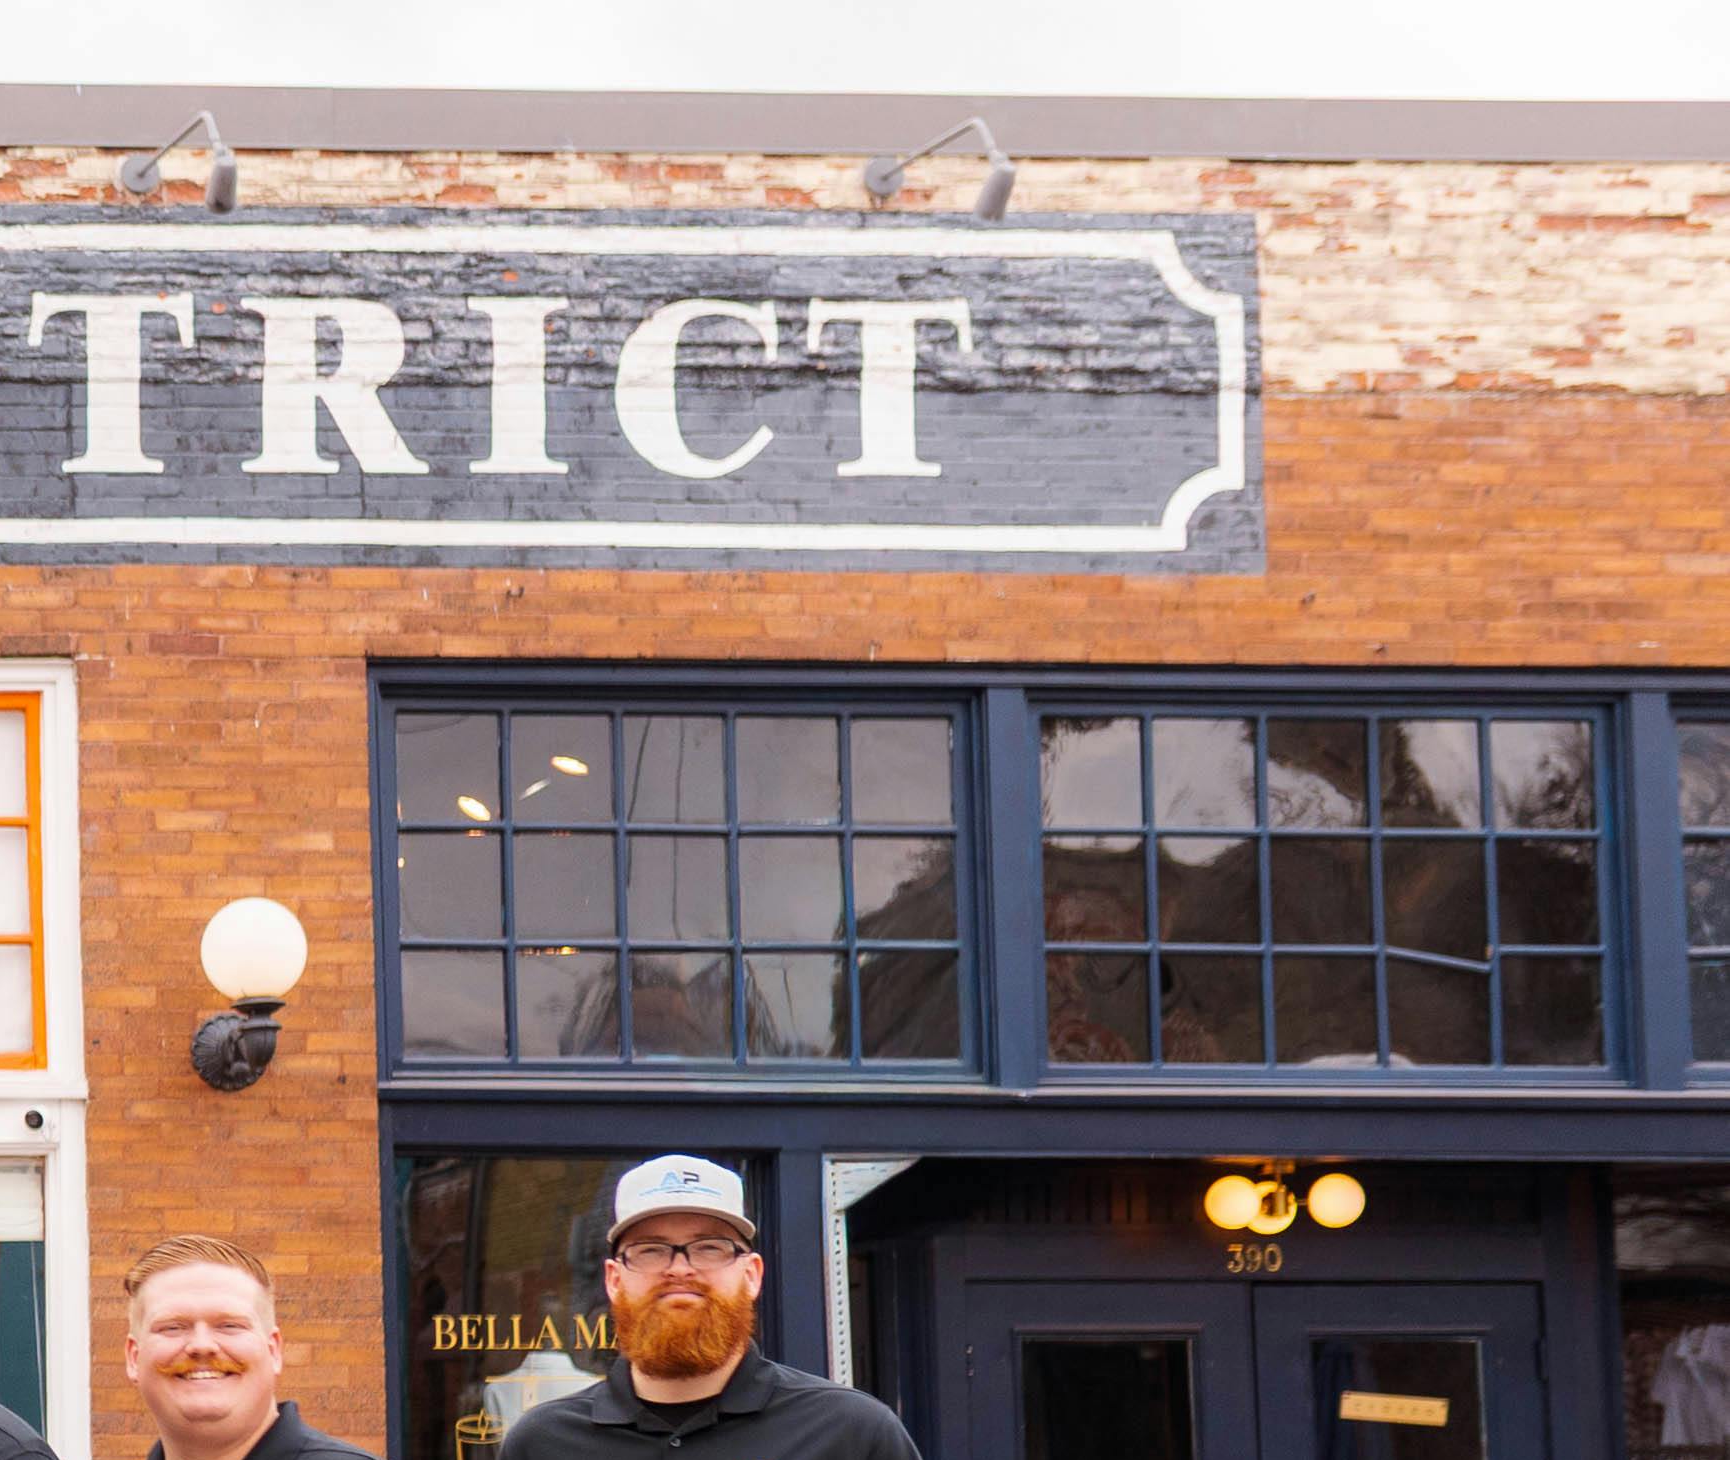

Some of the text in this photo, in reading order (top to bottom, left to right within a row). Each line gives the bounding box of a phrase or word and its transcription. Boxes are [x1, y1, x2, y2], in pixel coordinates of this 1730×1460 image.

[660, 1171, 699, 1186] AP
[1227, 1243, 1282, 1273] 390
[432, 1314, 563, 1350] BELLA
